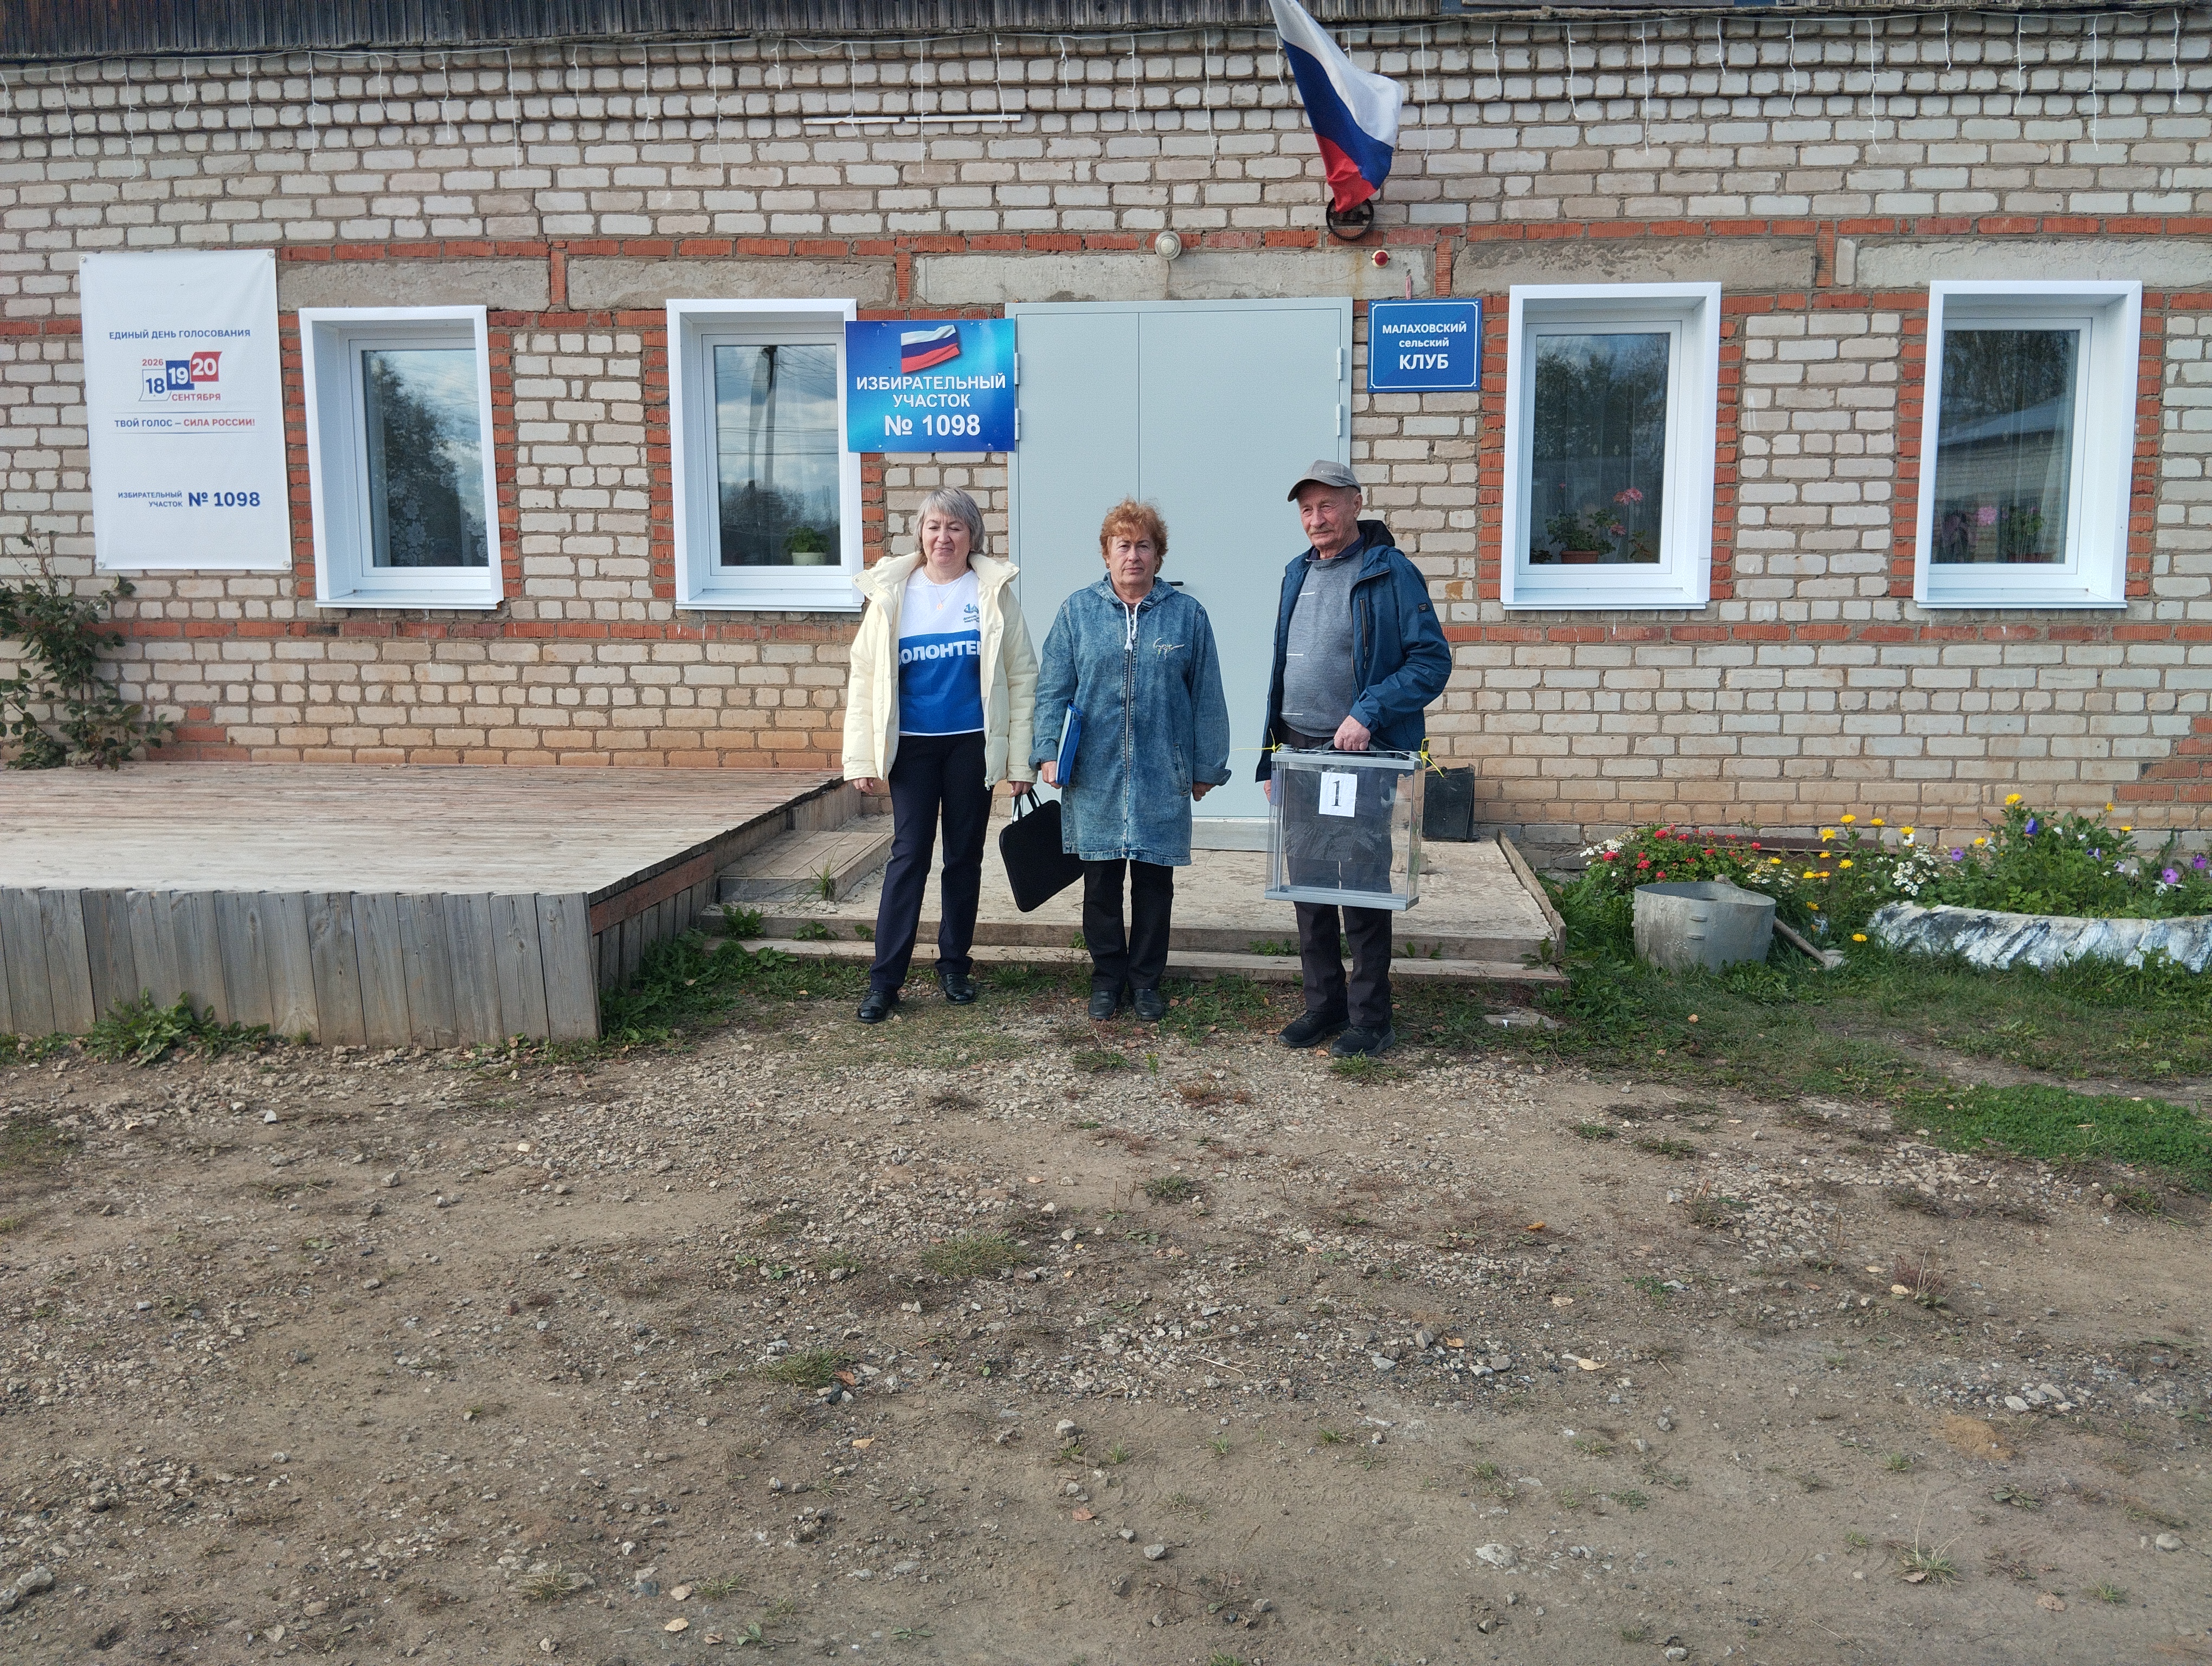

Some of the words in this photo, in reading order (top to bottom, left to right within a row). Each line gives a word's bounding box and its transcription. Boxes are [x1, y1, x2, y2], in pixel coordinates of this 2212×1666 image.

[109, 329, 149, 340] ЕДИНЫЙ
[151, 330, 176, 339] ДЕНЬ
[179, 330, 250, 338] ГОЛОСОВАНИЯ
[1382, 321, 1467, 334] МАЛАХОВСКИЙ
[1399, 337, 1449, 347] сельский
[192, 358, 217, 376] 20
[1399, 354, 1449, 369] КЛУБ
[168, 367, 189, 385] 19
[857, 373, 1006, 390] ИЗБИРАТЕЛЬНЫЙ
[145, 377, 165, 394] 18
[171, 393, 221, 401] СЕНТЯБРЯ
[893, 394, 970, 407] УЧАСТОК
[114, 418, 139, 427] ТВОЙ
[142, 419, 172, 427] ГОЛОС
[183, 419, 209, 427] СИЛА
[212, 418, 255, 426] РОССИИ!
[885, 415, 913, 436] №
[922, 414, 980, 436] 1098
[118, 490, 182, 498] ИЗБИРАТЕЛЬНЫЙ
[188, 492, 208, 507] №
[214, 491, 261, 507] 1098
[899, 640, 981, 665] ОЛОНТЕ
[1332, 780, 1341, 807] 1
